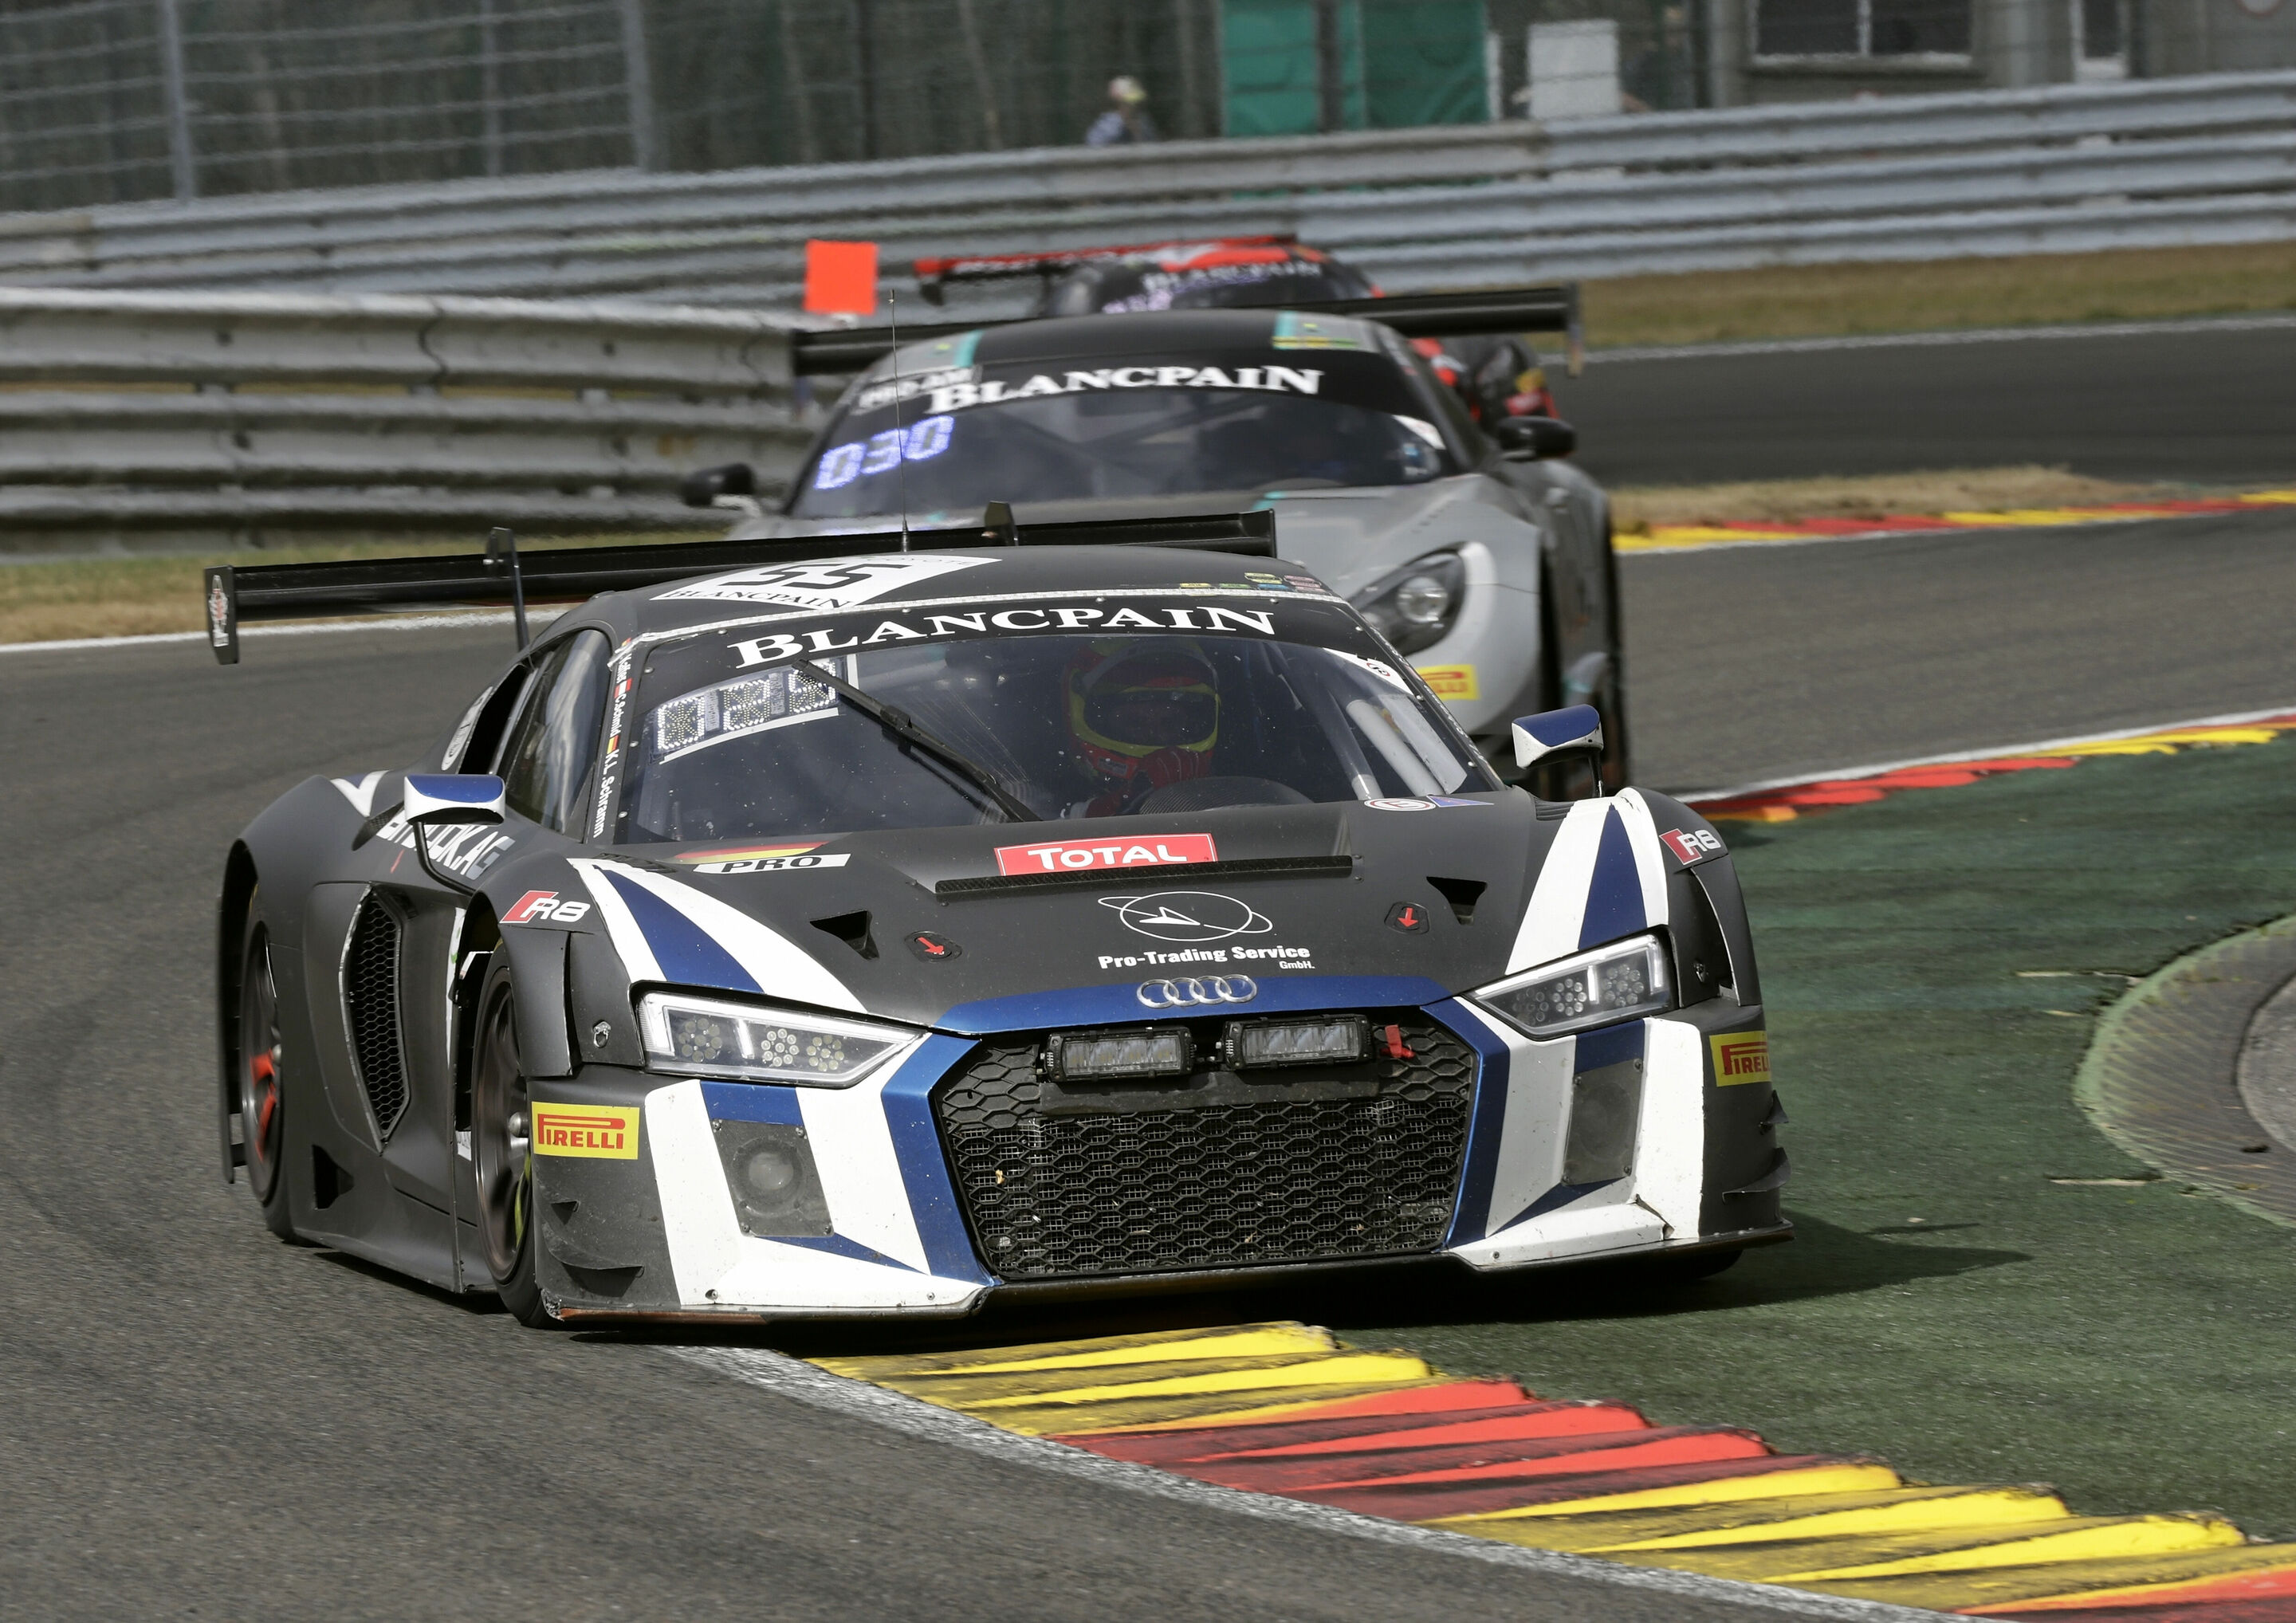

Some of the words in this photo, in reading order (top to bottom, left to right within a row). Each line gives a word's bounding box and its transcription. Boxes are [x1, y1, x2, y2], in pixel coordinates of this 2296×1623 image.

[926, 365, 1325, 414] BLANCPAIN
[813, 415, 954, 489] 030
[664, 591, 855, 609] BLANCPAIN
[727, 607, 1275, 669] BLANCPAIN
[1674, 829, 1721, 857] R8
[721, 857, 822, 873] PRO
[1028, 845, 1187, 870] TOTAL
[517, 896, 591, 922] R8
[1098, 949, 1228, 969] Pro-Trading
[1231, 945, 1311, 960] Service
[1720, 1041, 1769, 1076] PIREL
[537, 1114, 626, 1149] PIRELLI
